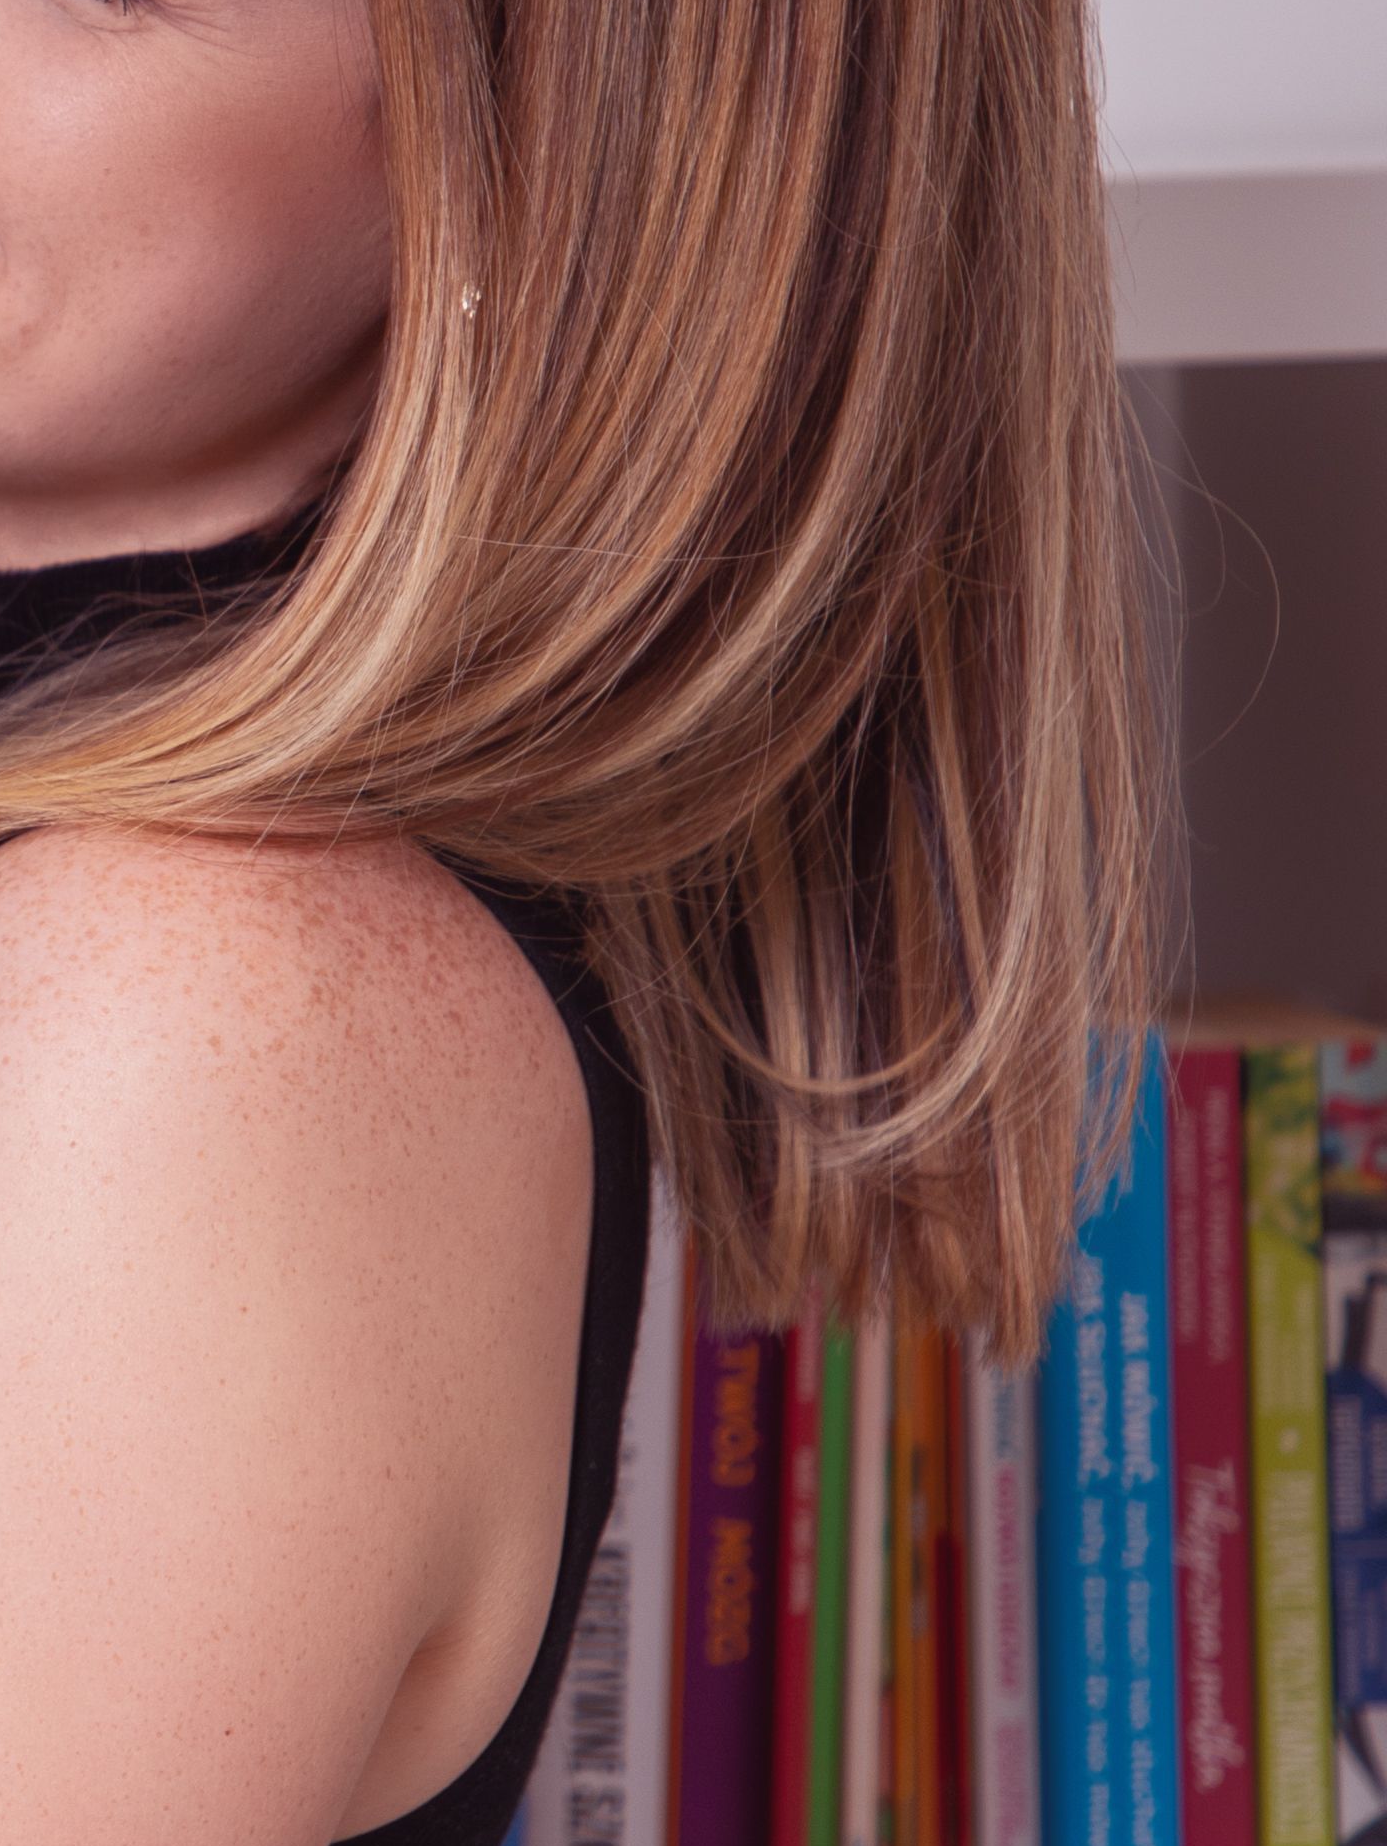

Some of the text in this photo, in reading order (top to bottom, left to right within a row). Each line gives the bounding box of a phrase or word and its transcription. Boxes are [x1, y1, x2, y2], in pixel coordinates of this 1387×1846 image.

[1119, 1292, 1149, 1352] JAK
[707, 1341, 763, 1666] TWÓJ MÓZG
